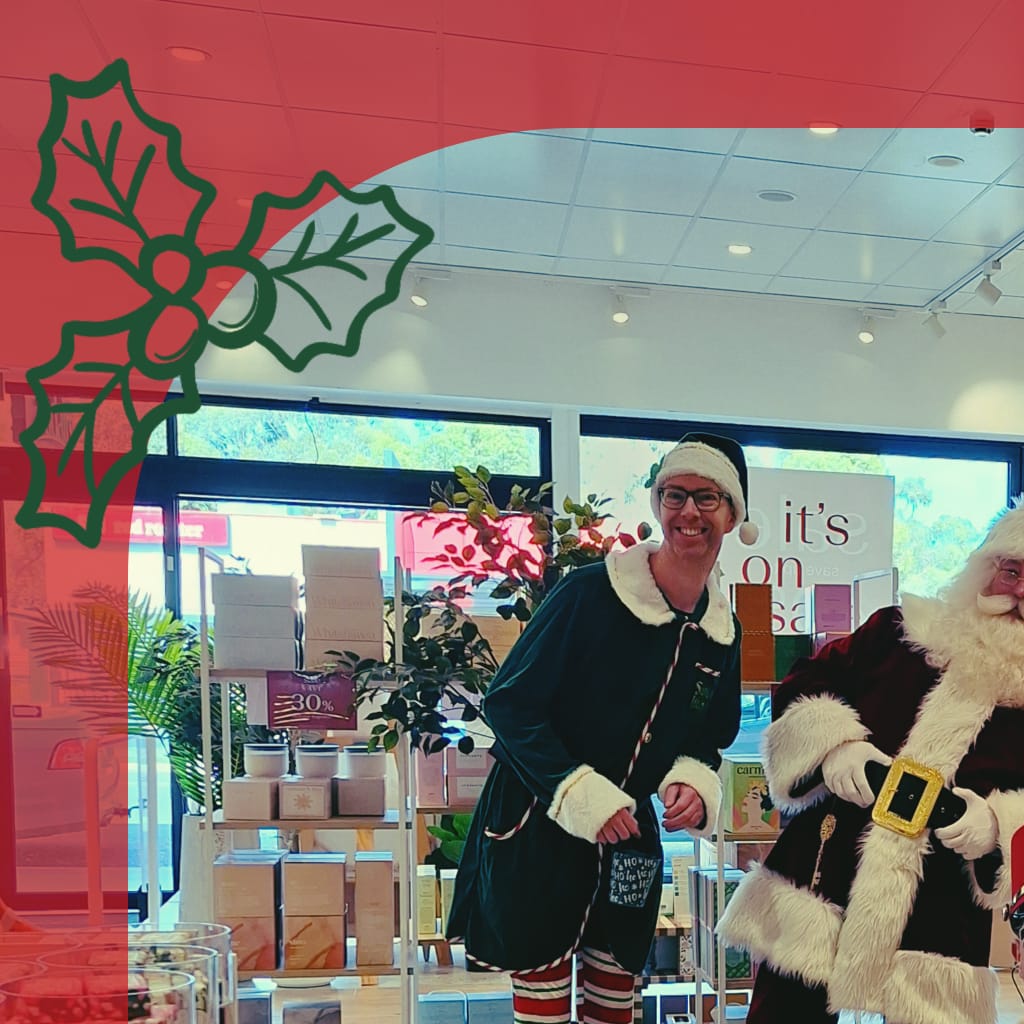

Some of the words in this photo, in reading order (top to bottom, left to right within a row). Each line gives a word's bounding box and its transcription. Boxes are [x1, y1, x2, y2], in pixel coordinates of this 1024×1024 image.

[785, 500, 849, 546] it's
[742, 555, 803, 588] on
[771, 601, 806, 633] sa
[291, 693, 334, 712] 30%
[737, 766, 765, 775] carn
